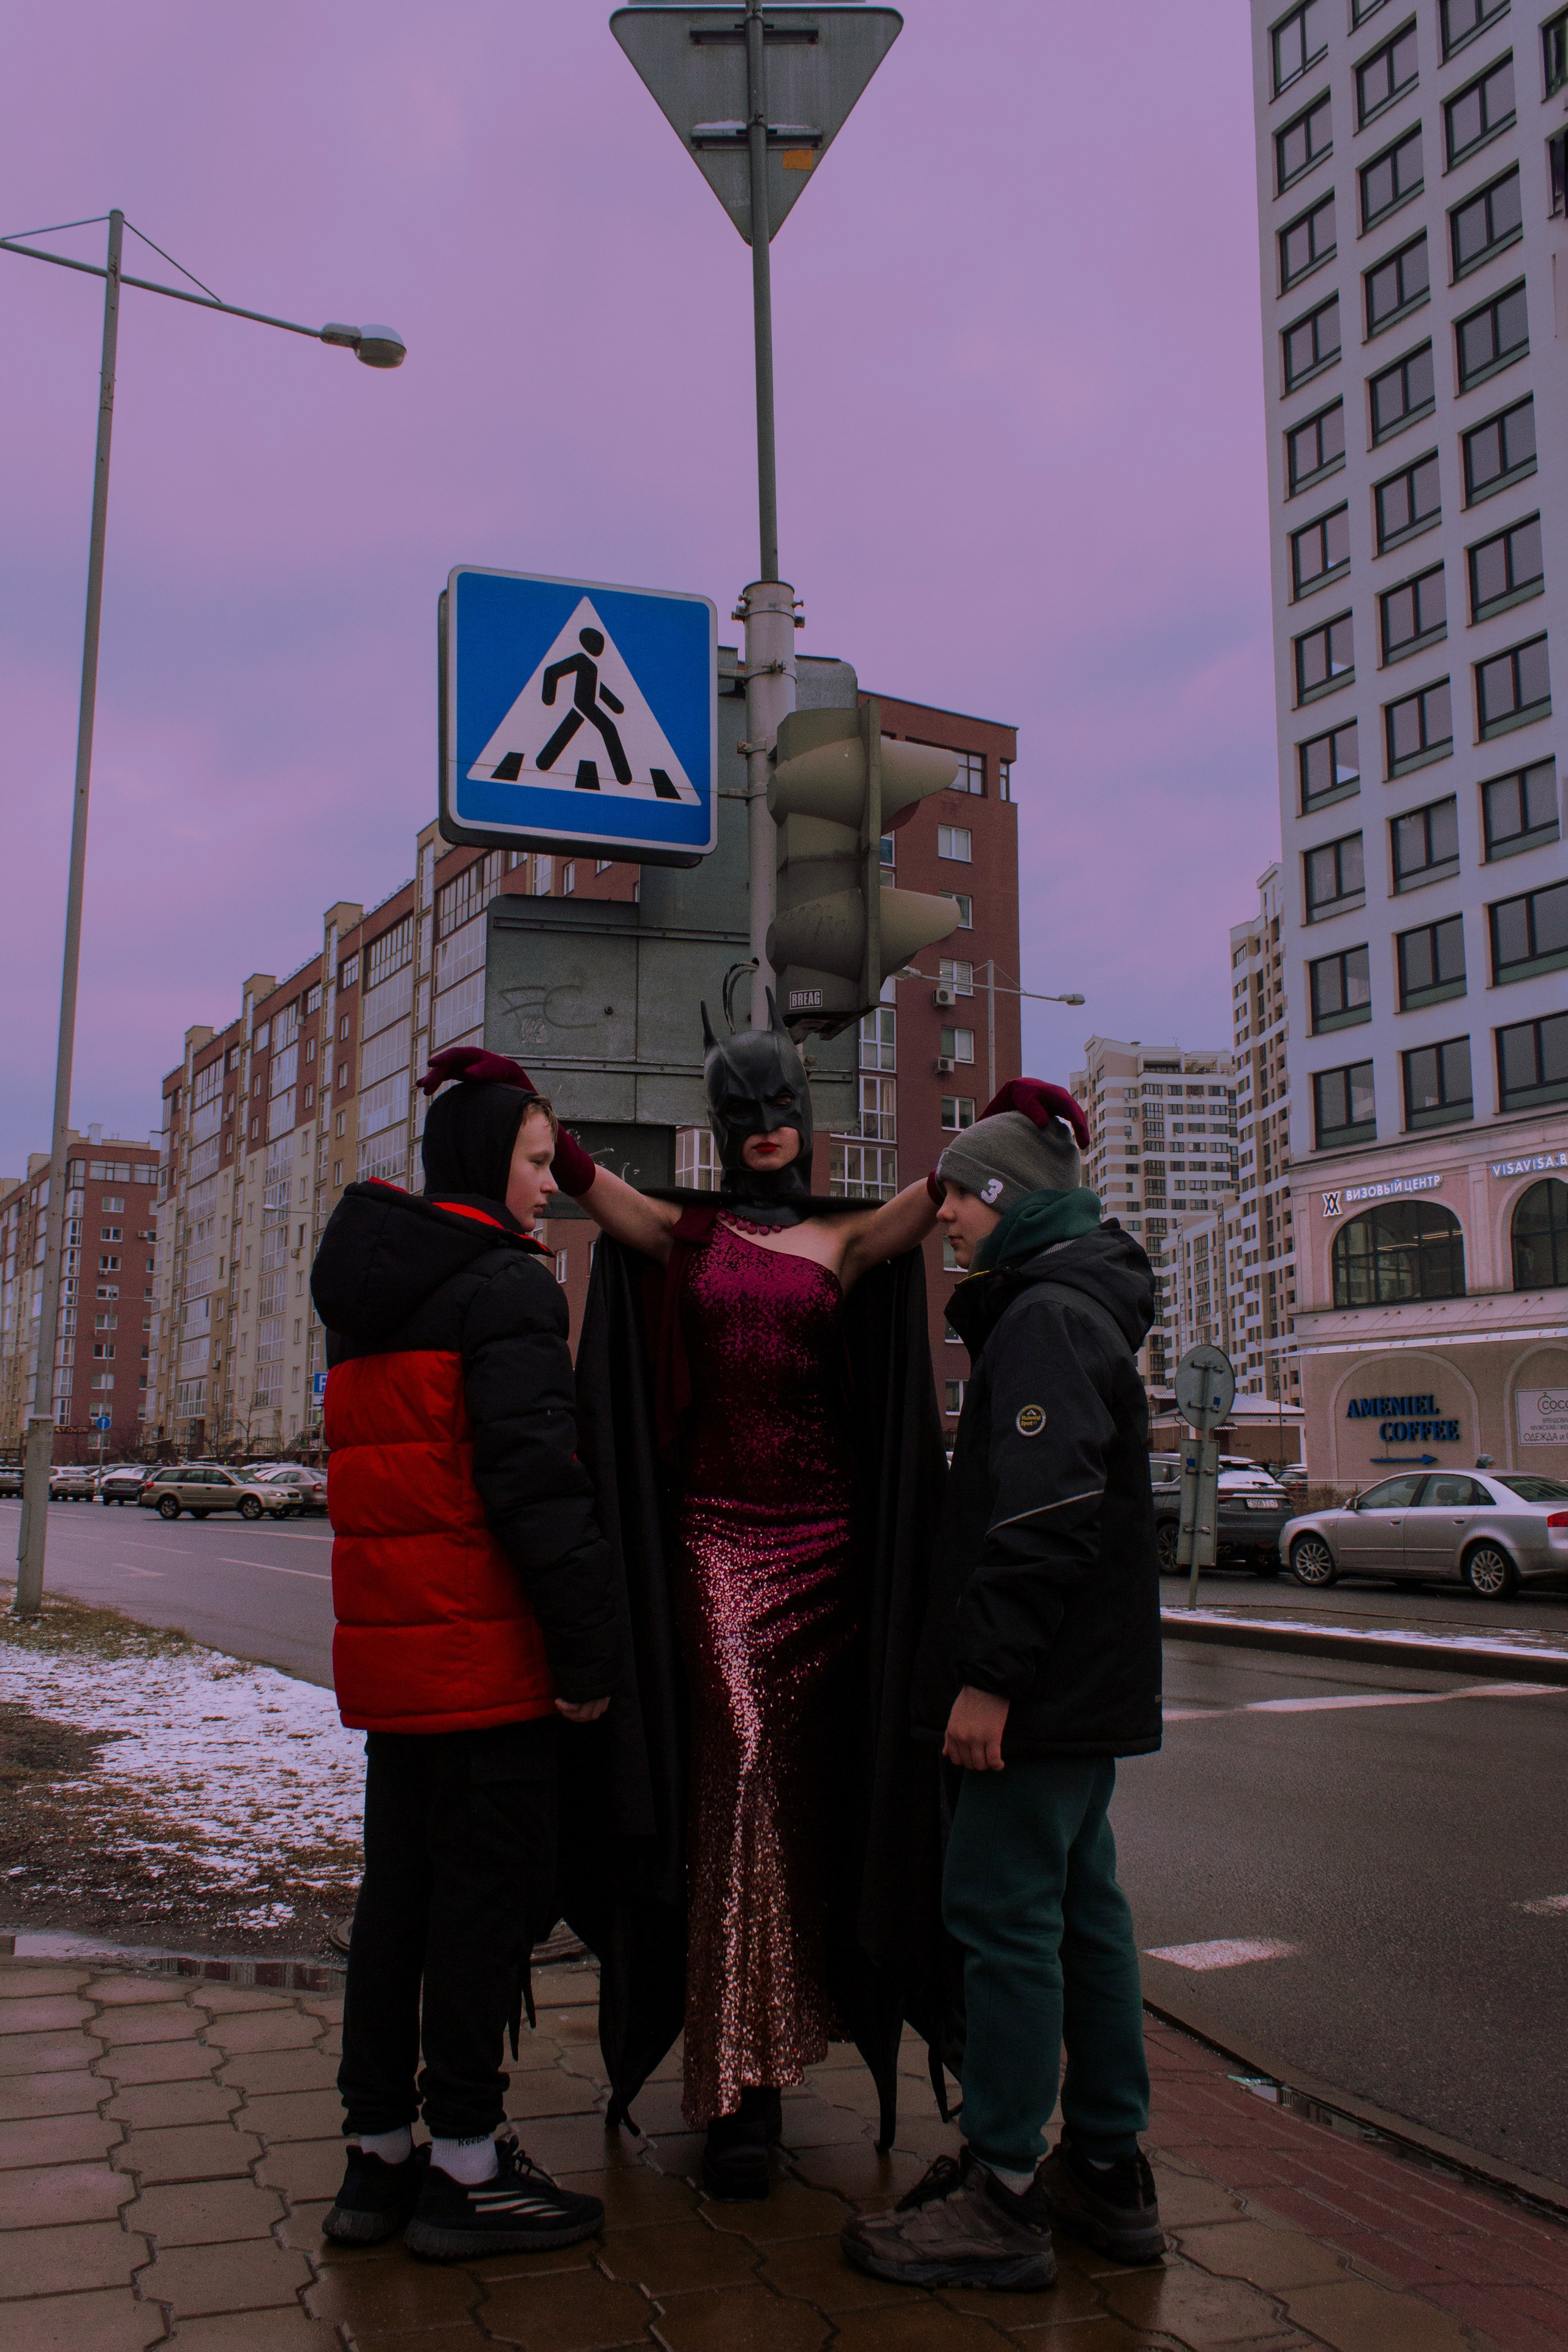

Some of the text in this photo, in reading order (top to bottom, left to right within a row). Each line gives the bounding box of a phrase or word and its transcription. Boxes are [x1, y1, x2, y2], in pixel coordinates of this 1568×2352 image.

[791, 991, 821, 1007] BREAG
[981, 1178, 1003, 1204] 3
[1346, 1175, 1441, 1201] ВИЗОВЫЙ ЦЕНТР
[319, 1375, 327, 1391] P
[1346, 1395, 1440, 1418] AMENIEL
[1379, 1420, 1460, 1441] COFFEE
